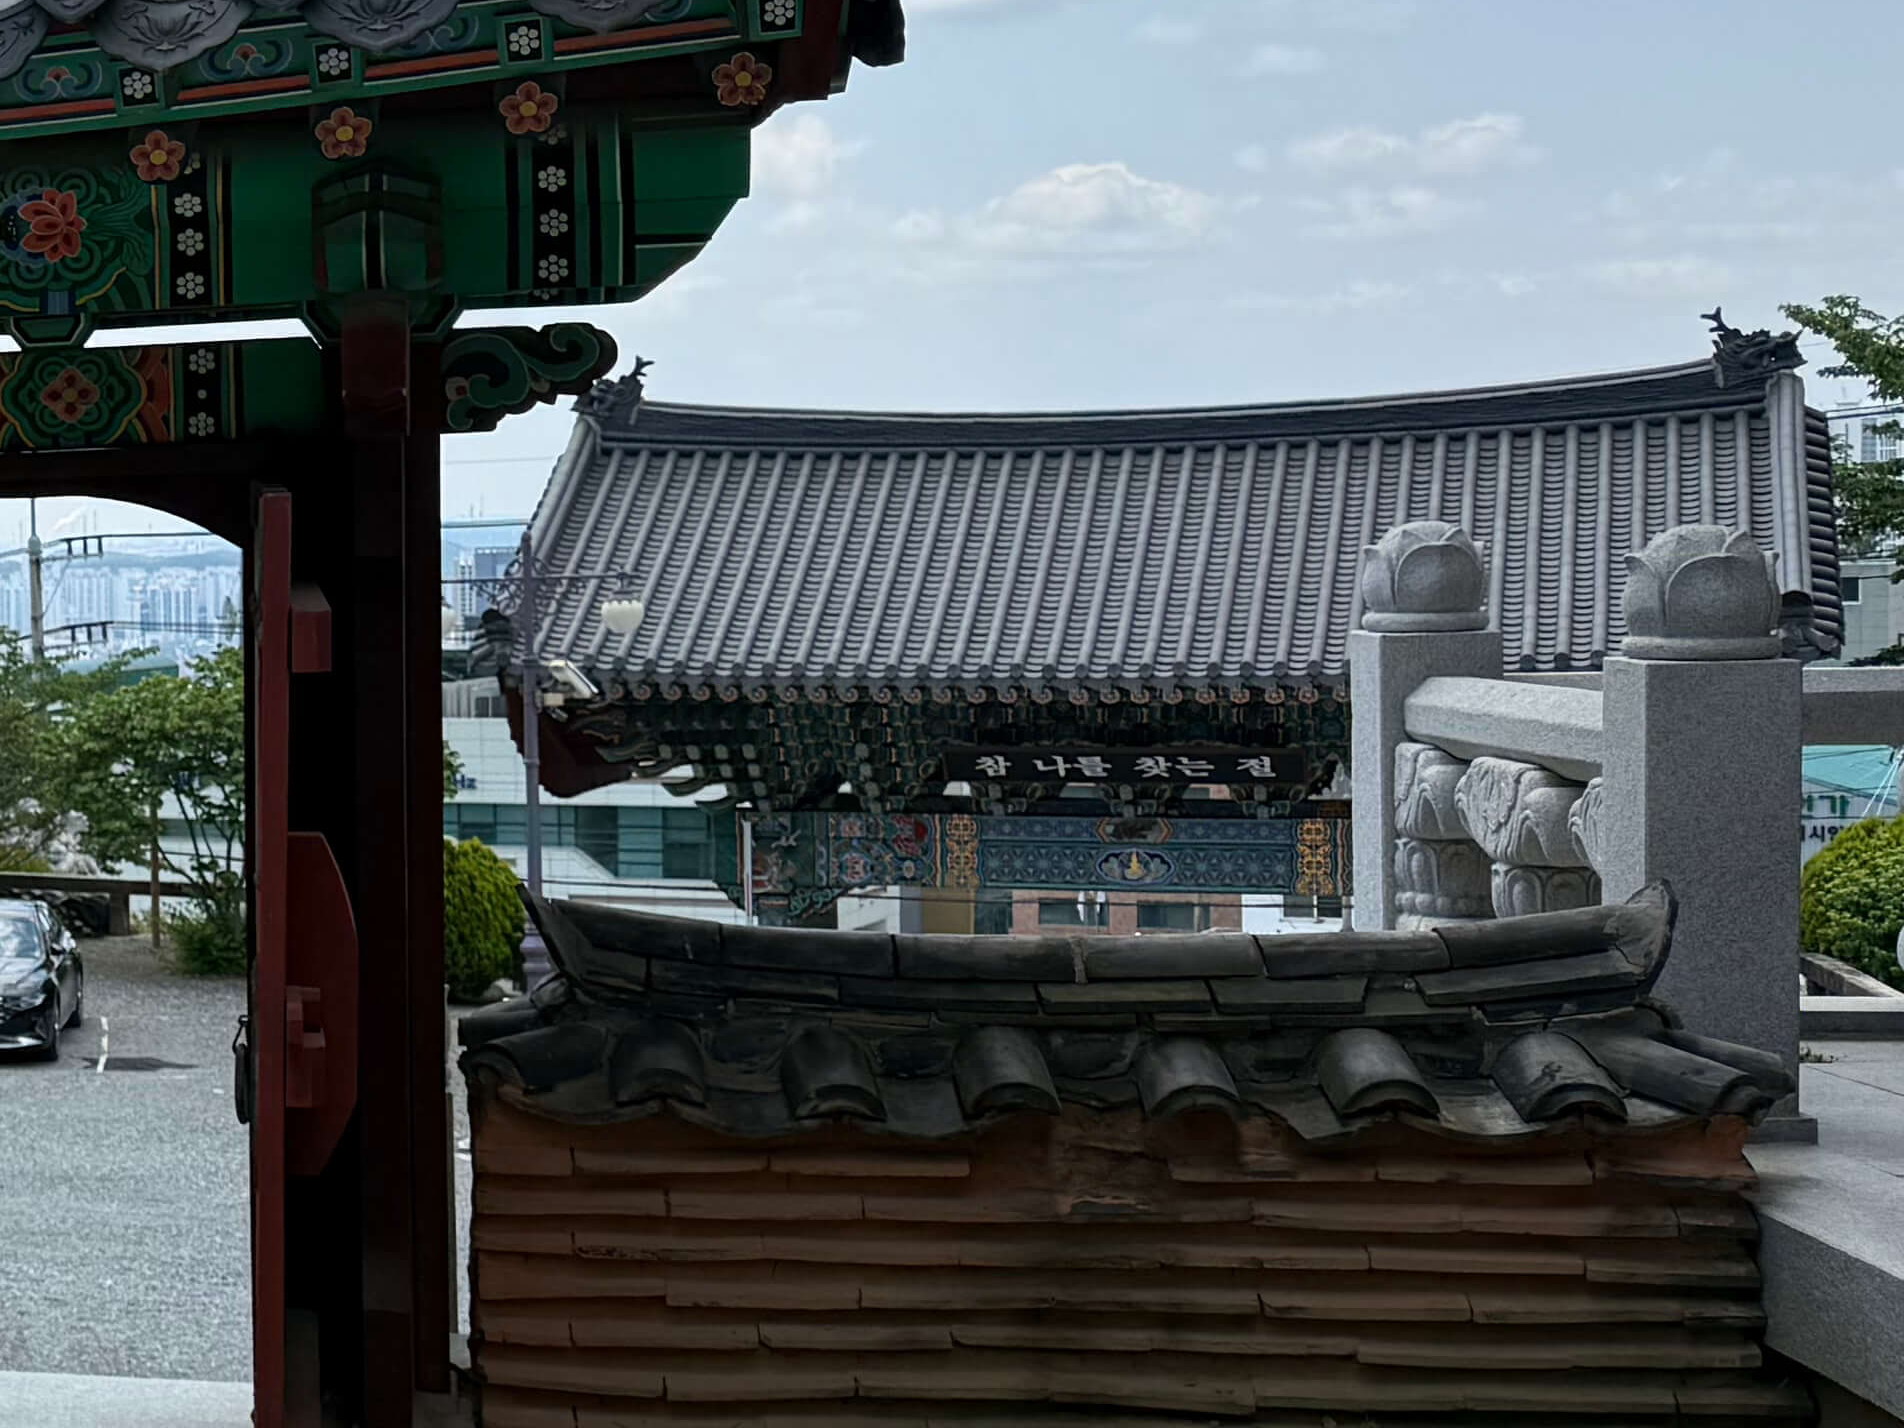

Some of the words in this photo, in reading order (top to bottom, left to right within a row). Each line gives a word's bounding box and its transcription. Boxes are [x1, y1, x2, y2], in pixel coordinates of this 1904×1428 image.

[975, 755, 1012, 777] 참
[1032, 755, 1112, 778] 나를
[1133, 755, 1215, 778] 찾는
[1237, 755, 1277, 778] 절
